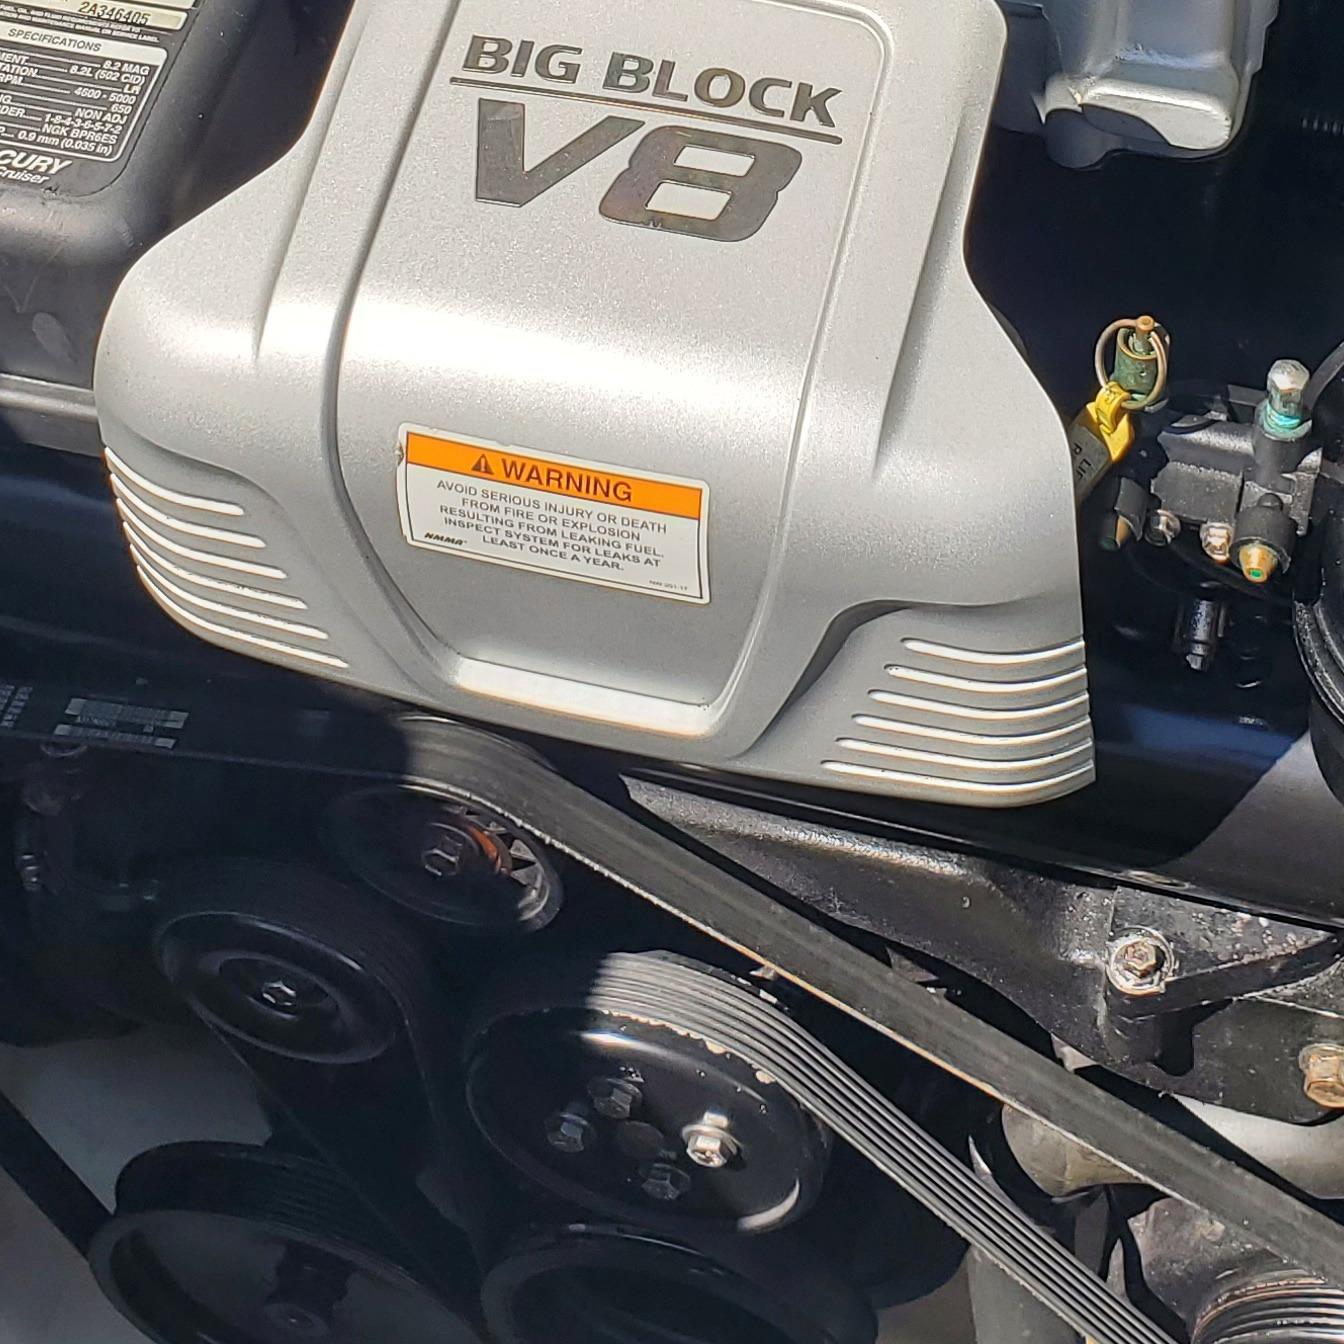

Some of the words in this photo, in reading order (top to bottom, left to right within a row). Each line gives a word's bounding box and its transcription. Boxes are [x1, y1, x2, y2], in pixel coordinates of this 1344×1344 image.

[8, 28, 102, 52] SPECIFICATIONS
[69, 65, 93, 77] 8.2L
[95, 69, 120, 81] (502
[121, 74, 146, 86] CID)
[103, 60, 121, 70] 8.2
[123, 63, 150, 75] MAG
[461, 34, 584, 84] BIG
[603, 50, 843, 128] BLOCK
[109, 93, 136, 105] 5000
[111, 104, 132, 115] 650
[45, 113, 122, 135] 1-8-4-3-6-5-7-2
[75, 108, 103, 120] NON
[104, 114, 128, 125] ADJ
[17, 131, 37, 141] 0.9
[37, 135, 60, 146] mm
[60, 138, 96, 153] (0.035
[96, 144, 113, 156] in)
[42, 124, 69, 136] NGK
[70, 128, 118, 145] BPR6ES
[475, 97, 803, 243] V8
[501, 458, 632, 502] WARNING
[437, 480, 477, 496] AVOID
[481, 489, 540, 509] SERIOUS
[545, 502, 593, 520] INJURY
[597, 512, 617, 525] OR
[621, 517, 667, 534] DEATH
[462, 498, 500, 514] FROM
[504, 507, 534, 520] FIRE
[538, 513, 557, 524] OR
[562, 518, 640, 541] EXPLOSION
[440, 505, 514, 528] RESULTING
[518, 522, 557, 537] FROM
[561, 531, 621, 550] LEAKING
[625, 543, 664, 558] FUEL.
[444, 517, 500, 535] INSPECT
[505, 530, 559, 547] SYSTEM
[563, 542, 591, 554] FOR
[595, 547, 640, 563] LEAKS
[644, 558, 661, 567] AT
[482, 535, 525, 551] LEAST
[529, 545, 567, 560] ONCE
[571, 554, 581, 562] A
[584, 556, 624, 570] YEAR.
